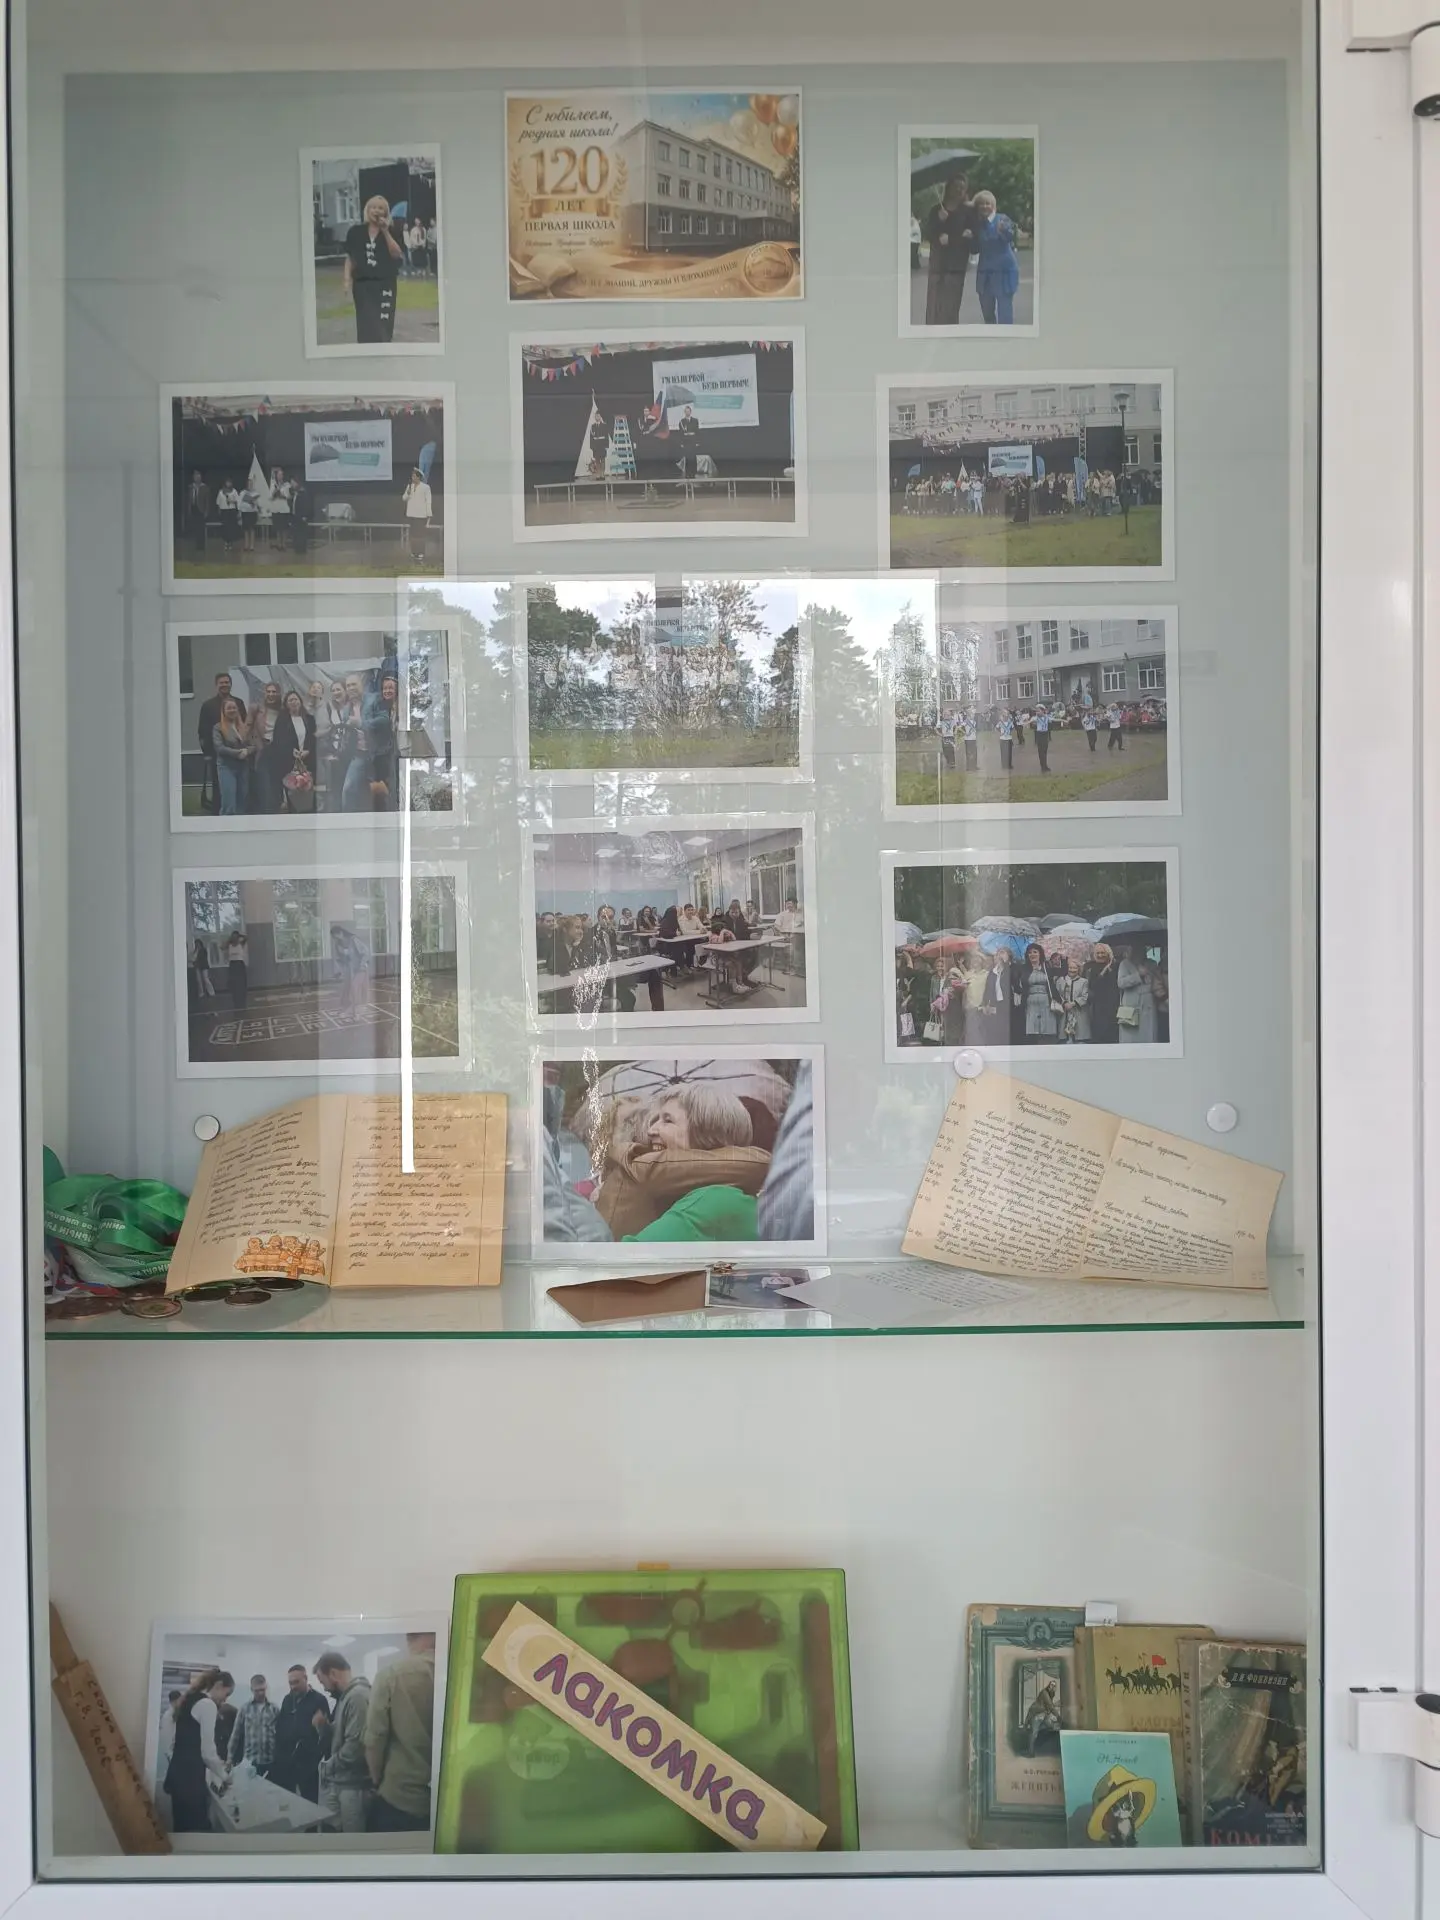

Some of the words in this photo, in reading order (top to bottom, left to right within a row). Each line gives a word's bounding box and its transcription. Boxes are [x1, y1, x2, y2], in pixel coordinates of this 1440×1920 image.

[525, 104, 542, 125] С
[544, 104, 613, 123] юбилеем,
[518, 126, 568, 143] родная
[569, 122, 619, 139] школа!
[529, 145, 611, 196] 120
[554, 199, 586, 213] ЛЕТ
[524, 221, 569, 232] ПЕРВАЯ
[573, 220, 616, 231] ШКОЛА
